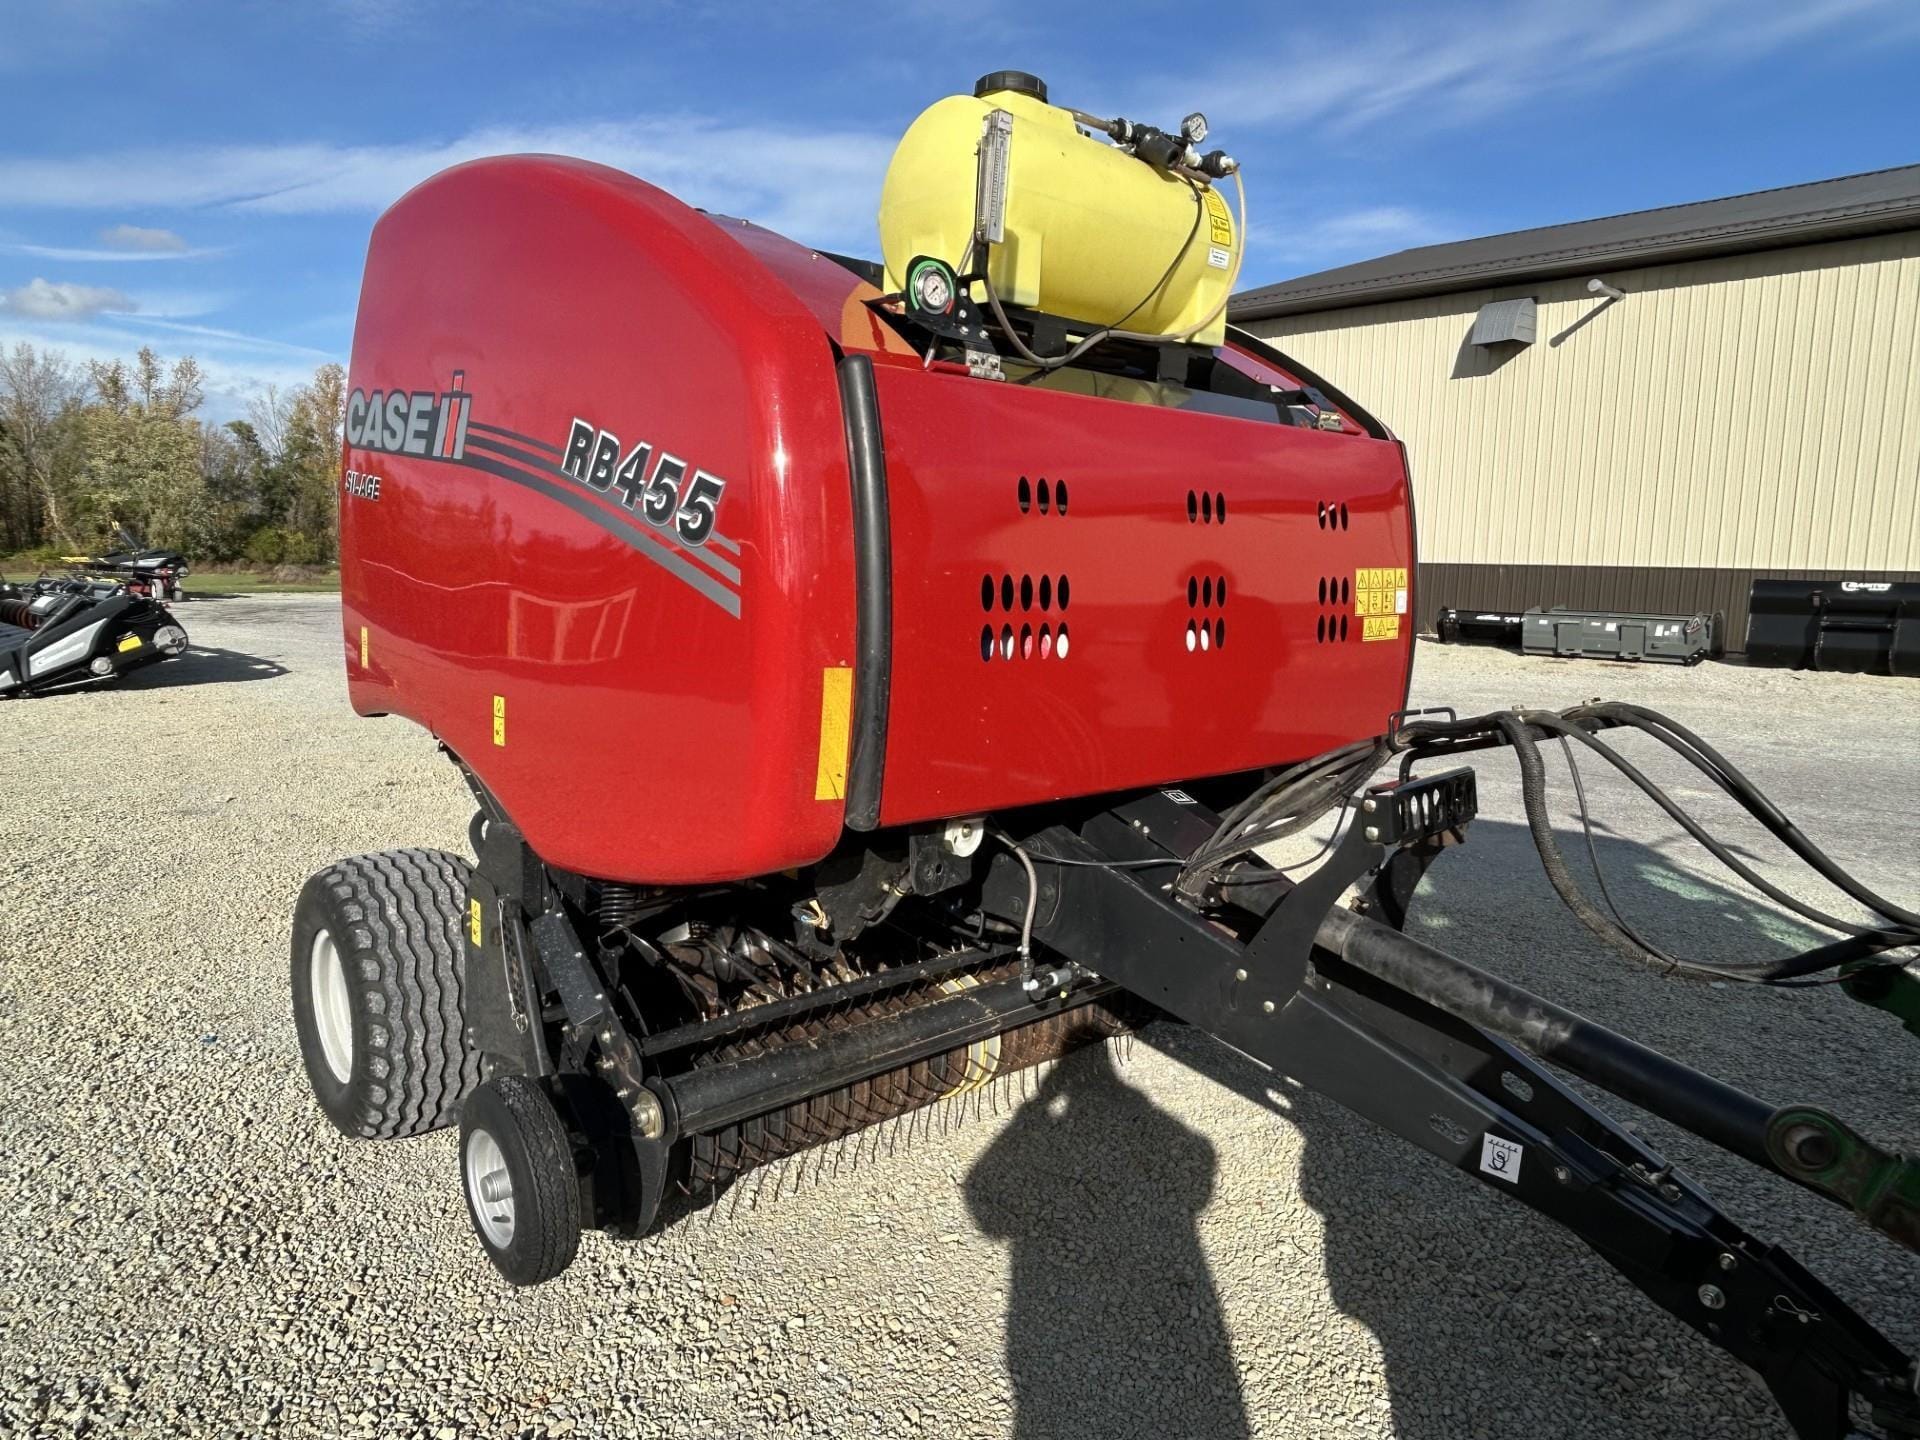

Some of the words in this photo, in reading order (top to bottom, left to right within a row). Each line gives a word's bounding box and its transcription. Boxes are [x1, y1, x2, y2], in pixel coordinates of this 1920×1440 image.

[345, 387, 434, 455] CASE
[345, 470, 381, 501] SILAGE
[561, 416, 726, 548] RB455
